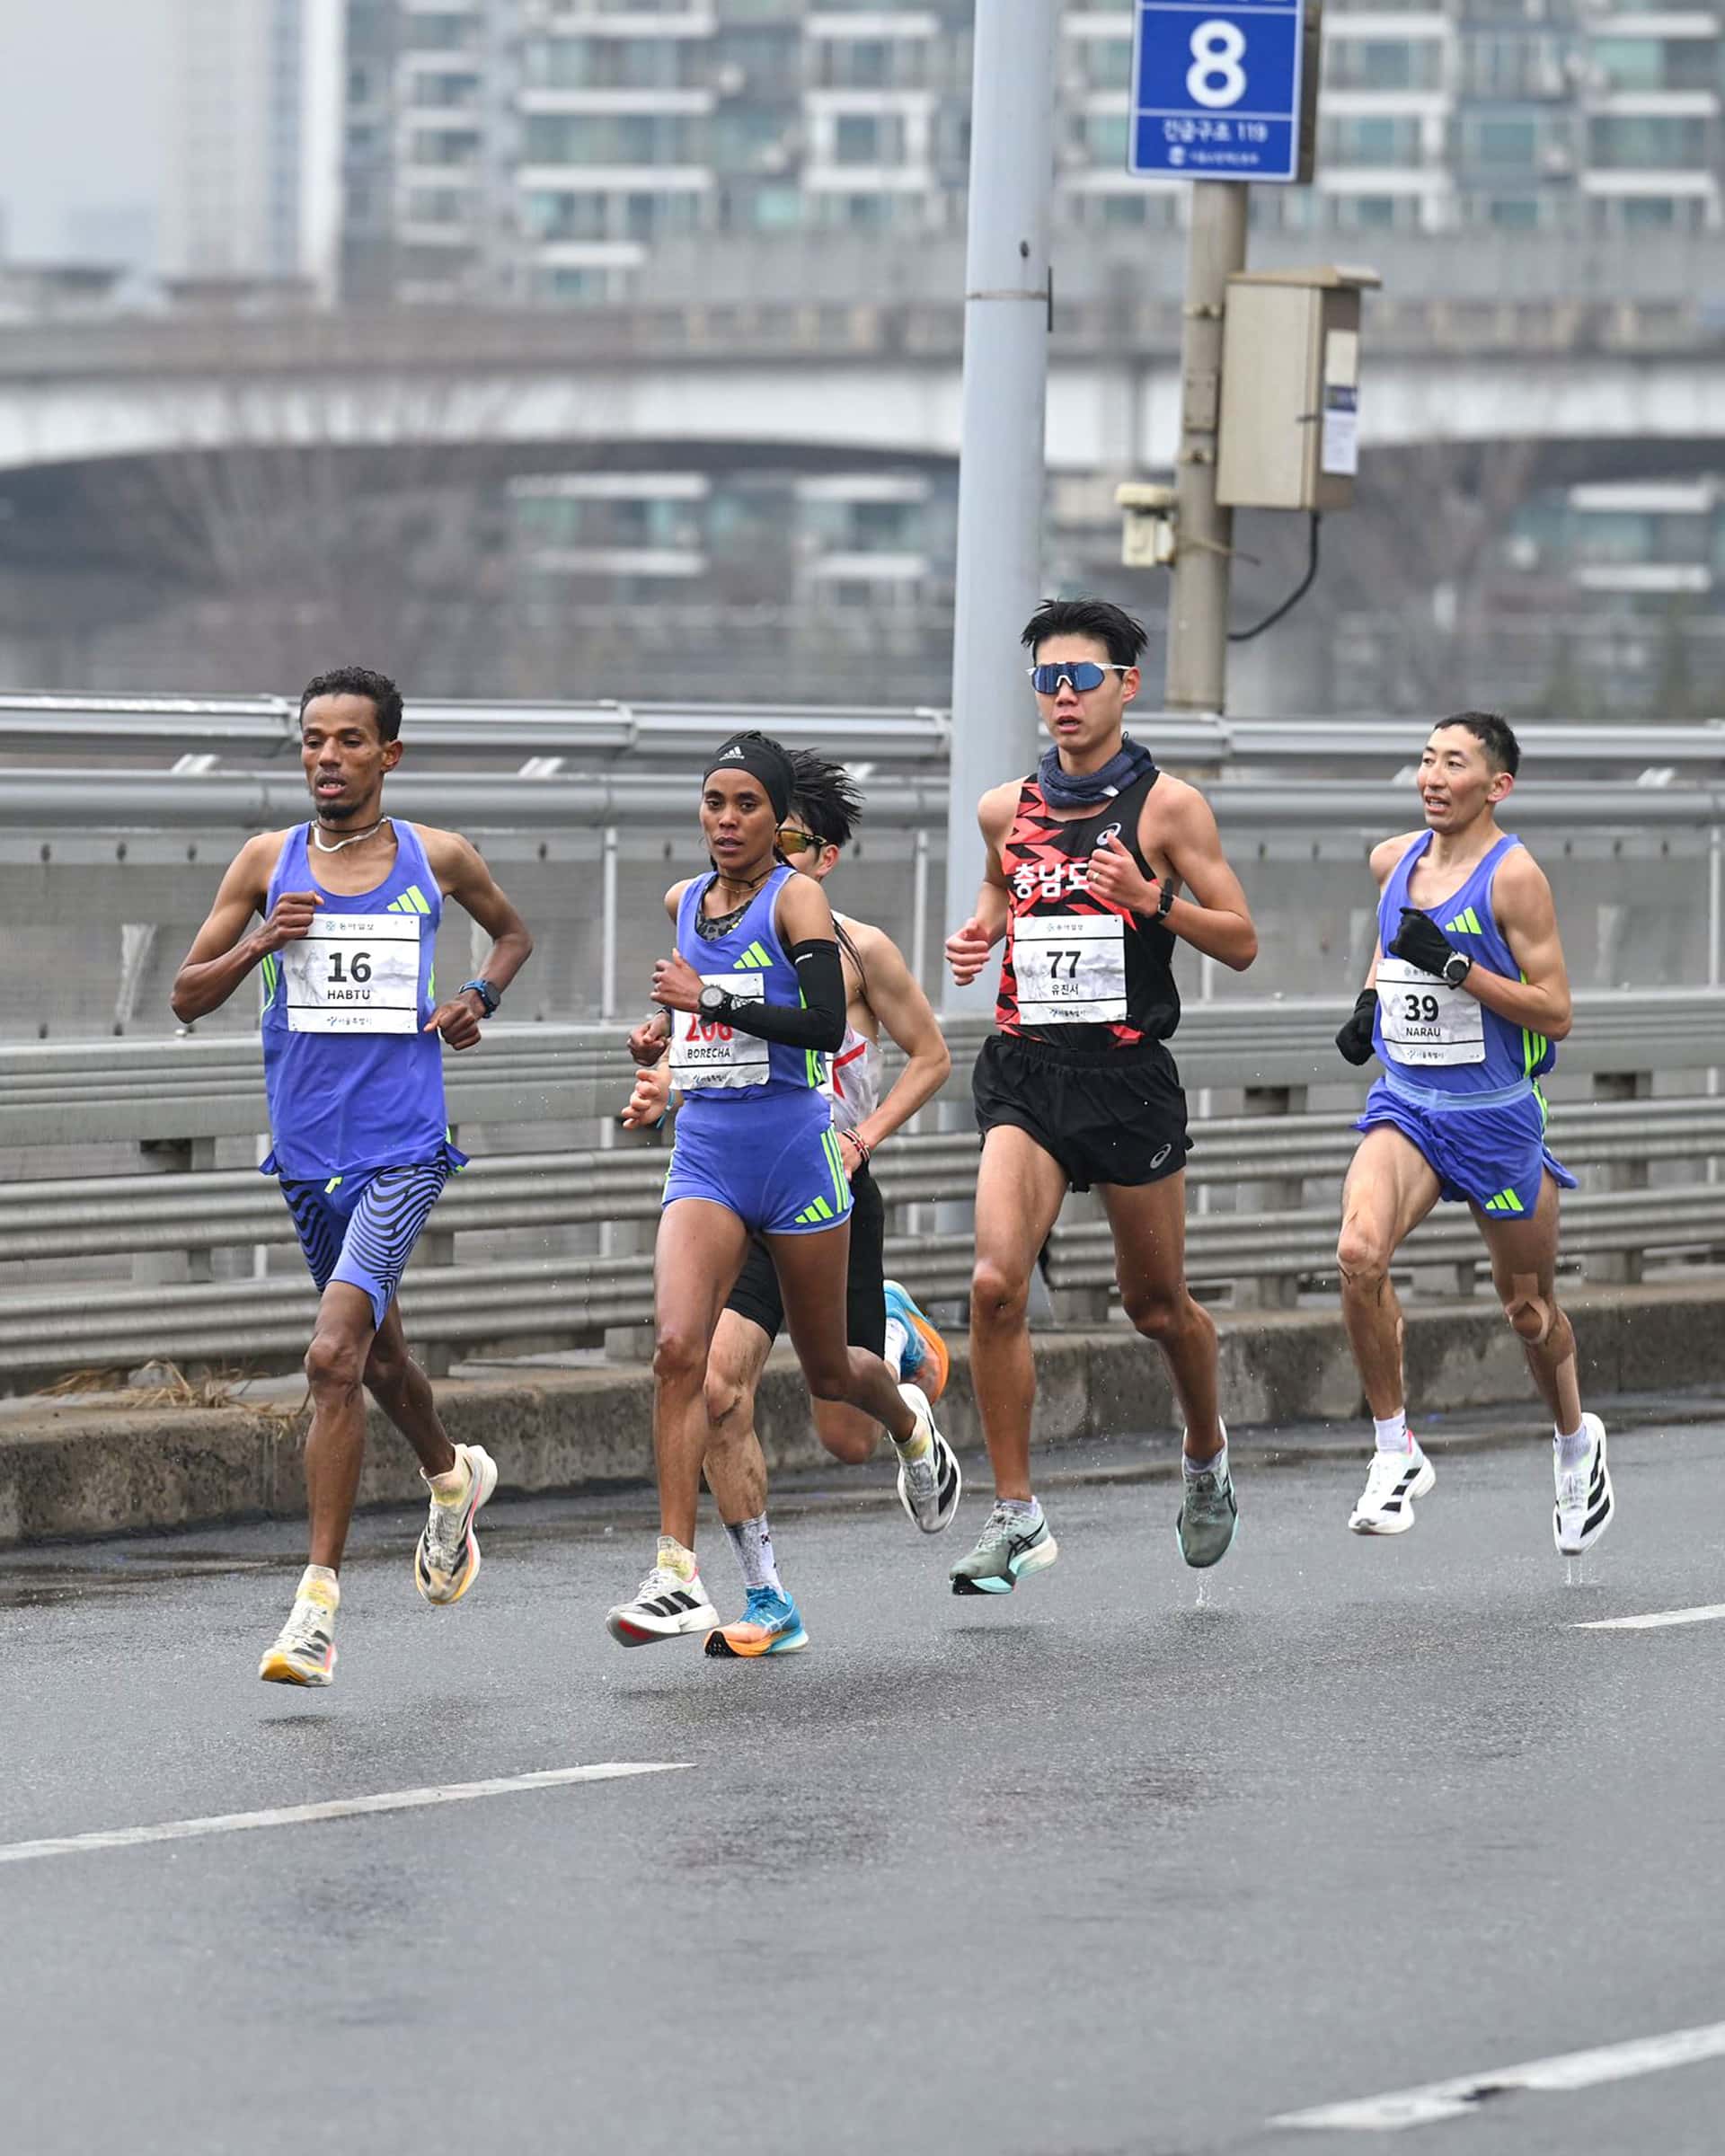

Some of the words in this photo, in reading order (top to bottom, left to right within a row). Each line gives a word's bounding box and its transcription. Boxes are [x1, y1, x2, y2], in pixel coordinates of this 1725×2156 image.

[1186, 19, 1246, 109] 8
[327, 951, 372, 983] 16
[1046, 950, 1082, 979] 77
[327, 990, 371, 1000] HABTU
[1051, 984, 1079, 996] 유진서
[1404, 994, 1439, 1022] 39
[1405, 1027, 1441, 1037] NARAU
[687, 1047, 730, 1058] BORECHA
